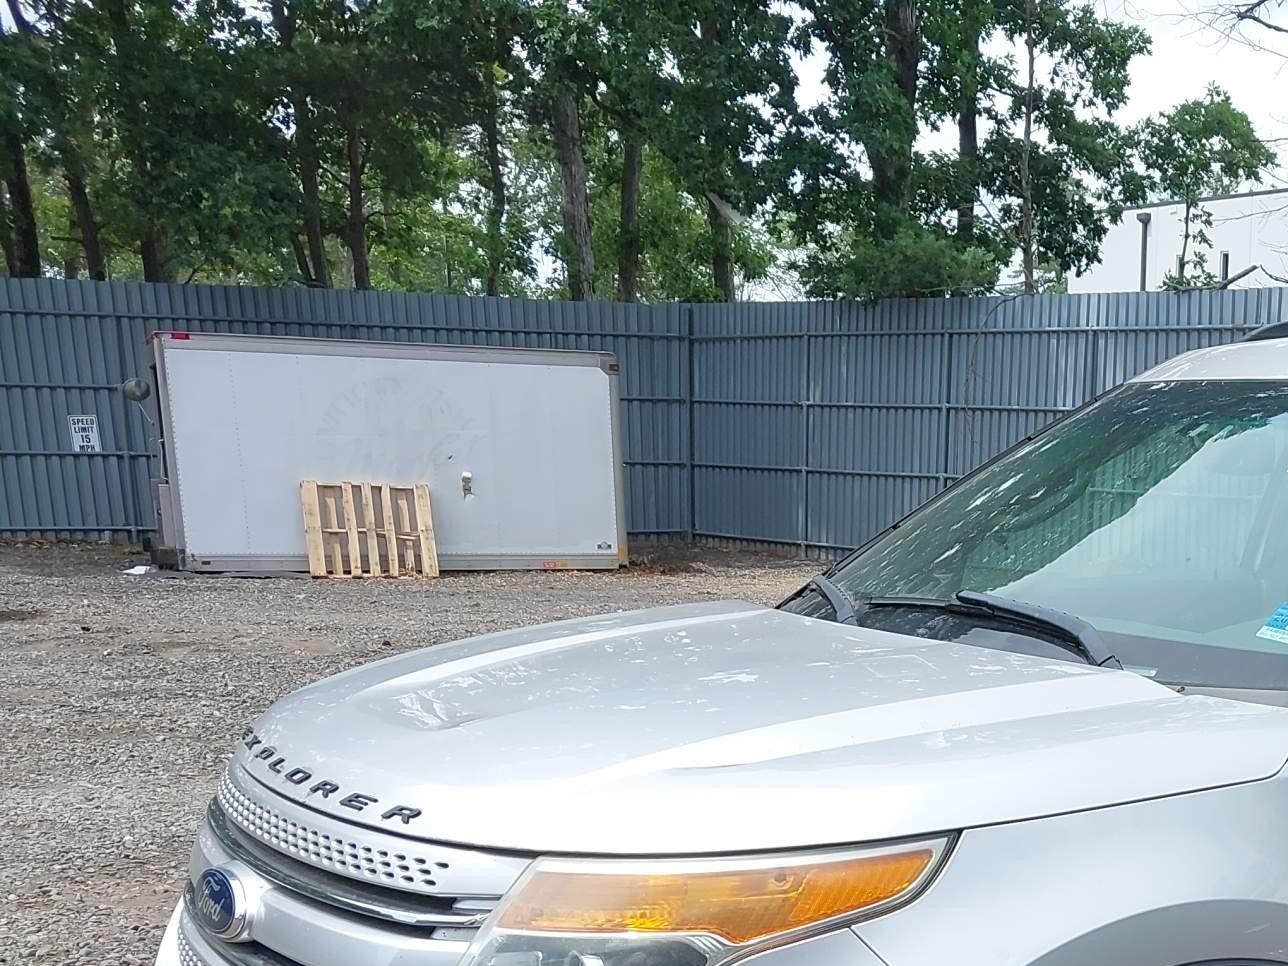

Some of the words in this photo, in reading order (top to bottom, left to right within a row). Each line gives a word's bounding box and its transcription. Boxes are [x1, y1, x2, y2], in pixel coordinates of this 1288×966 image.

[71, 418, 95, 426] SPEED
[73, 426, 94, 434] LIMIT
[80, 434, 92, 444] 15
[198, 876, 225, 922] Ford
